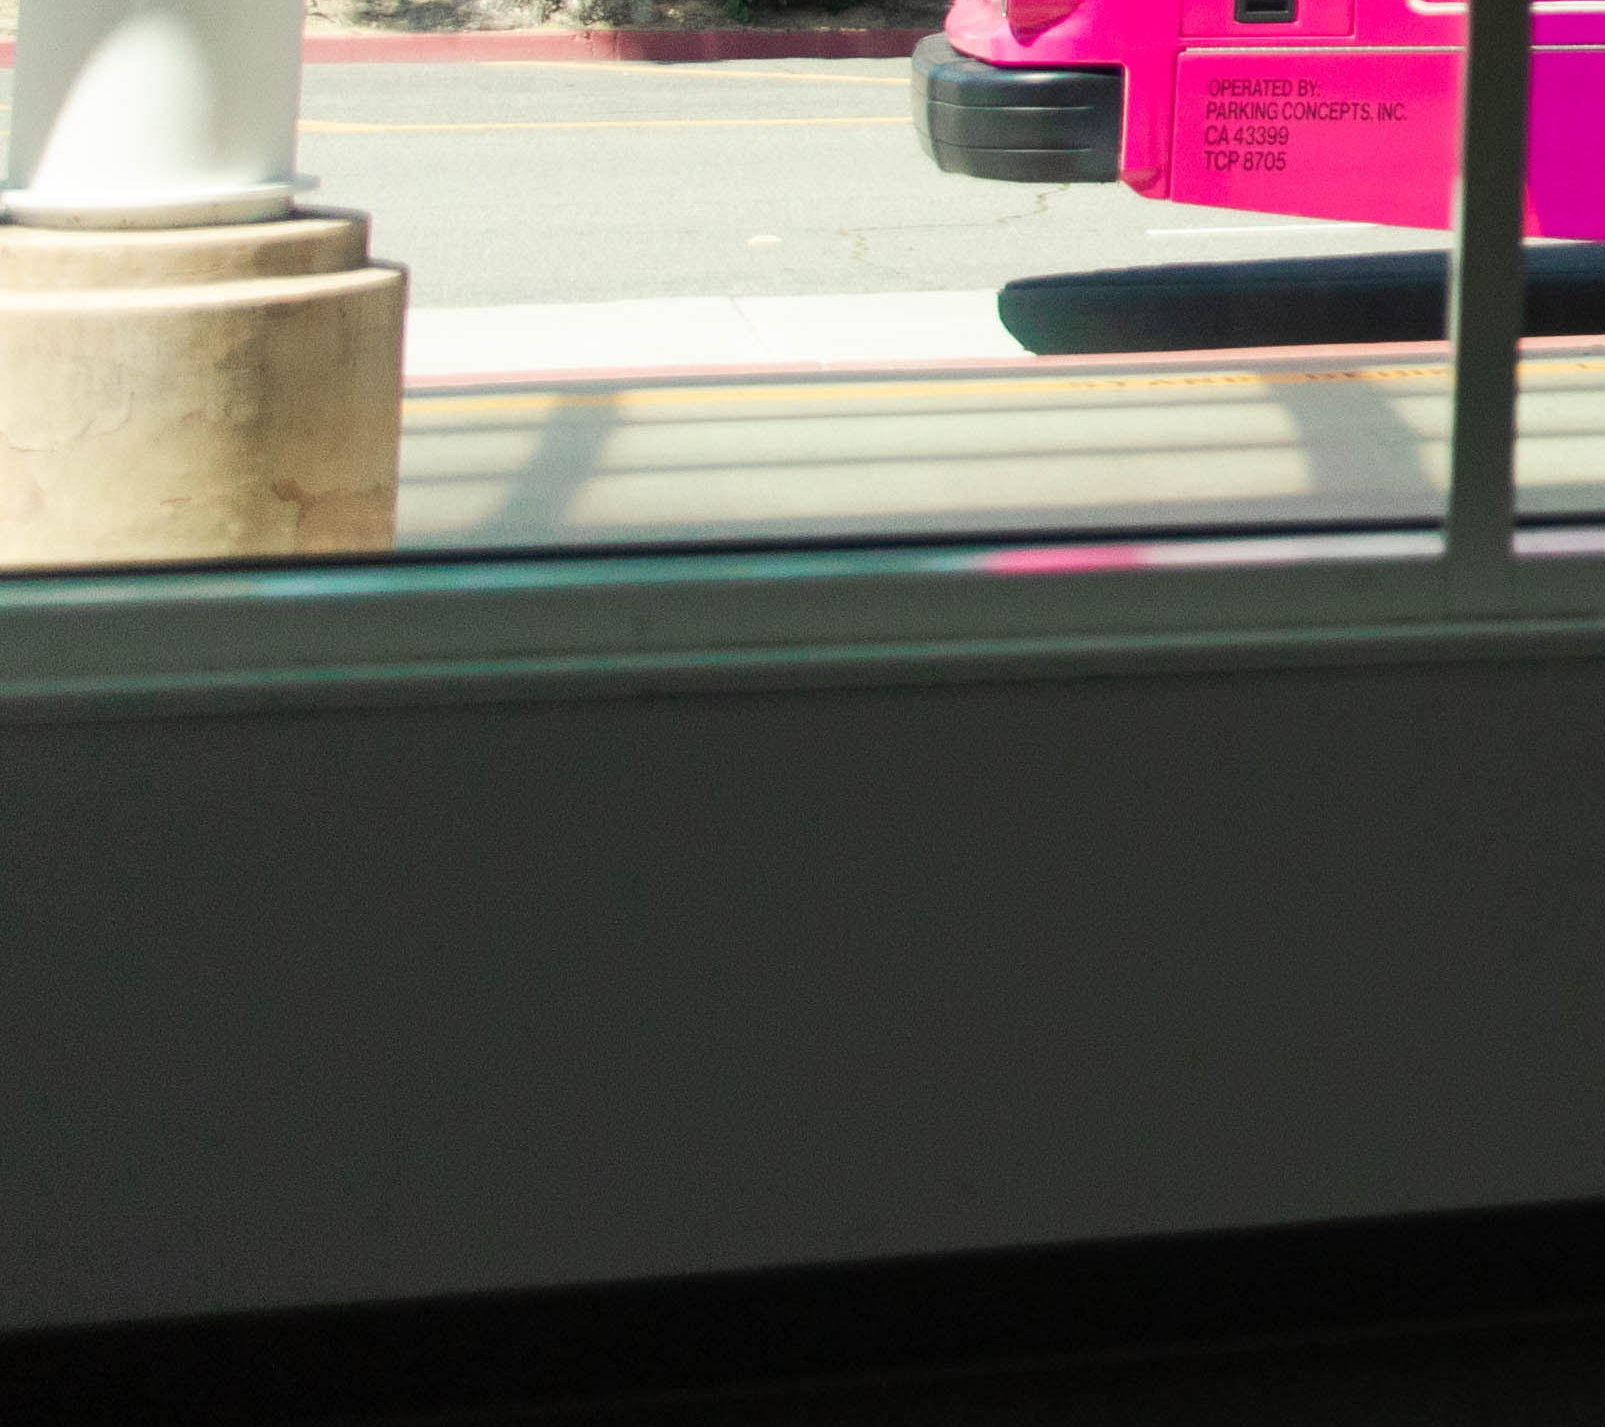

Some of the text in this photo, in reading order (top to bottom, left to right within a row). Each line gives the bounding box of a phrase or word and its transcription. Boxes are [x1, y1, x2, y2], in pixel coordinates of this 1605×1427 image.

[1208, 78, 1293, 97] OPERATED
[1205, 101, 1408, 123] PARKING CONCEPTS, INC.
[1205, 124, 1289, 146] CA 43399
[1204, 150, 1287, 171] TCP 8705
